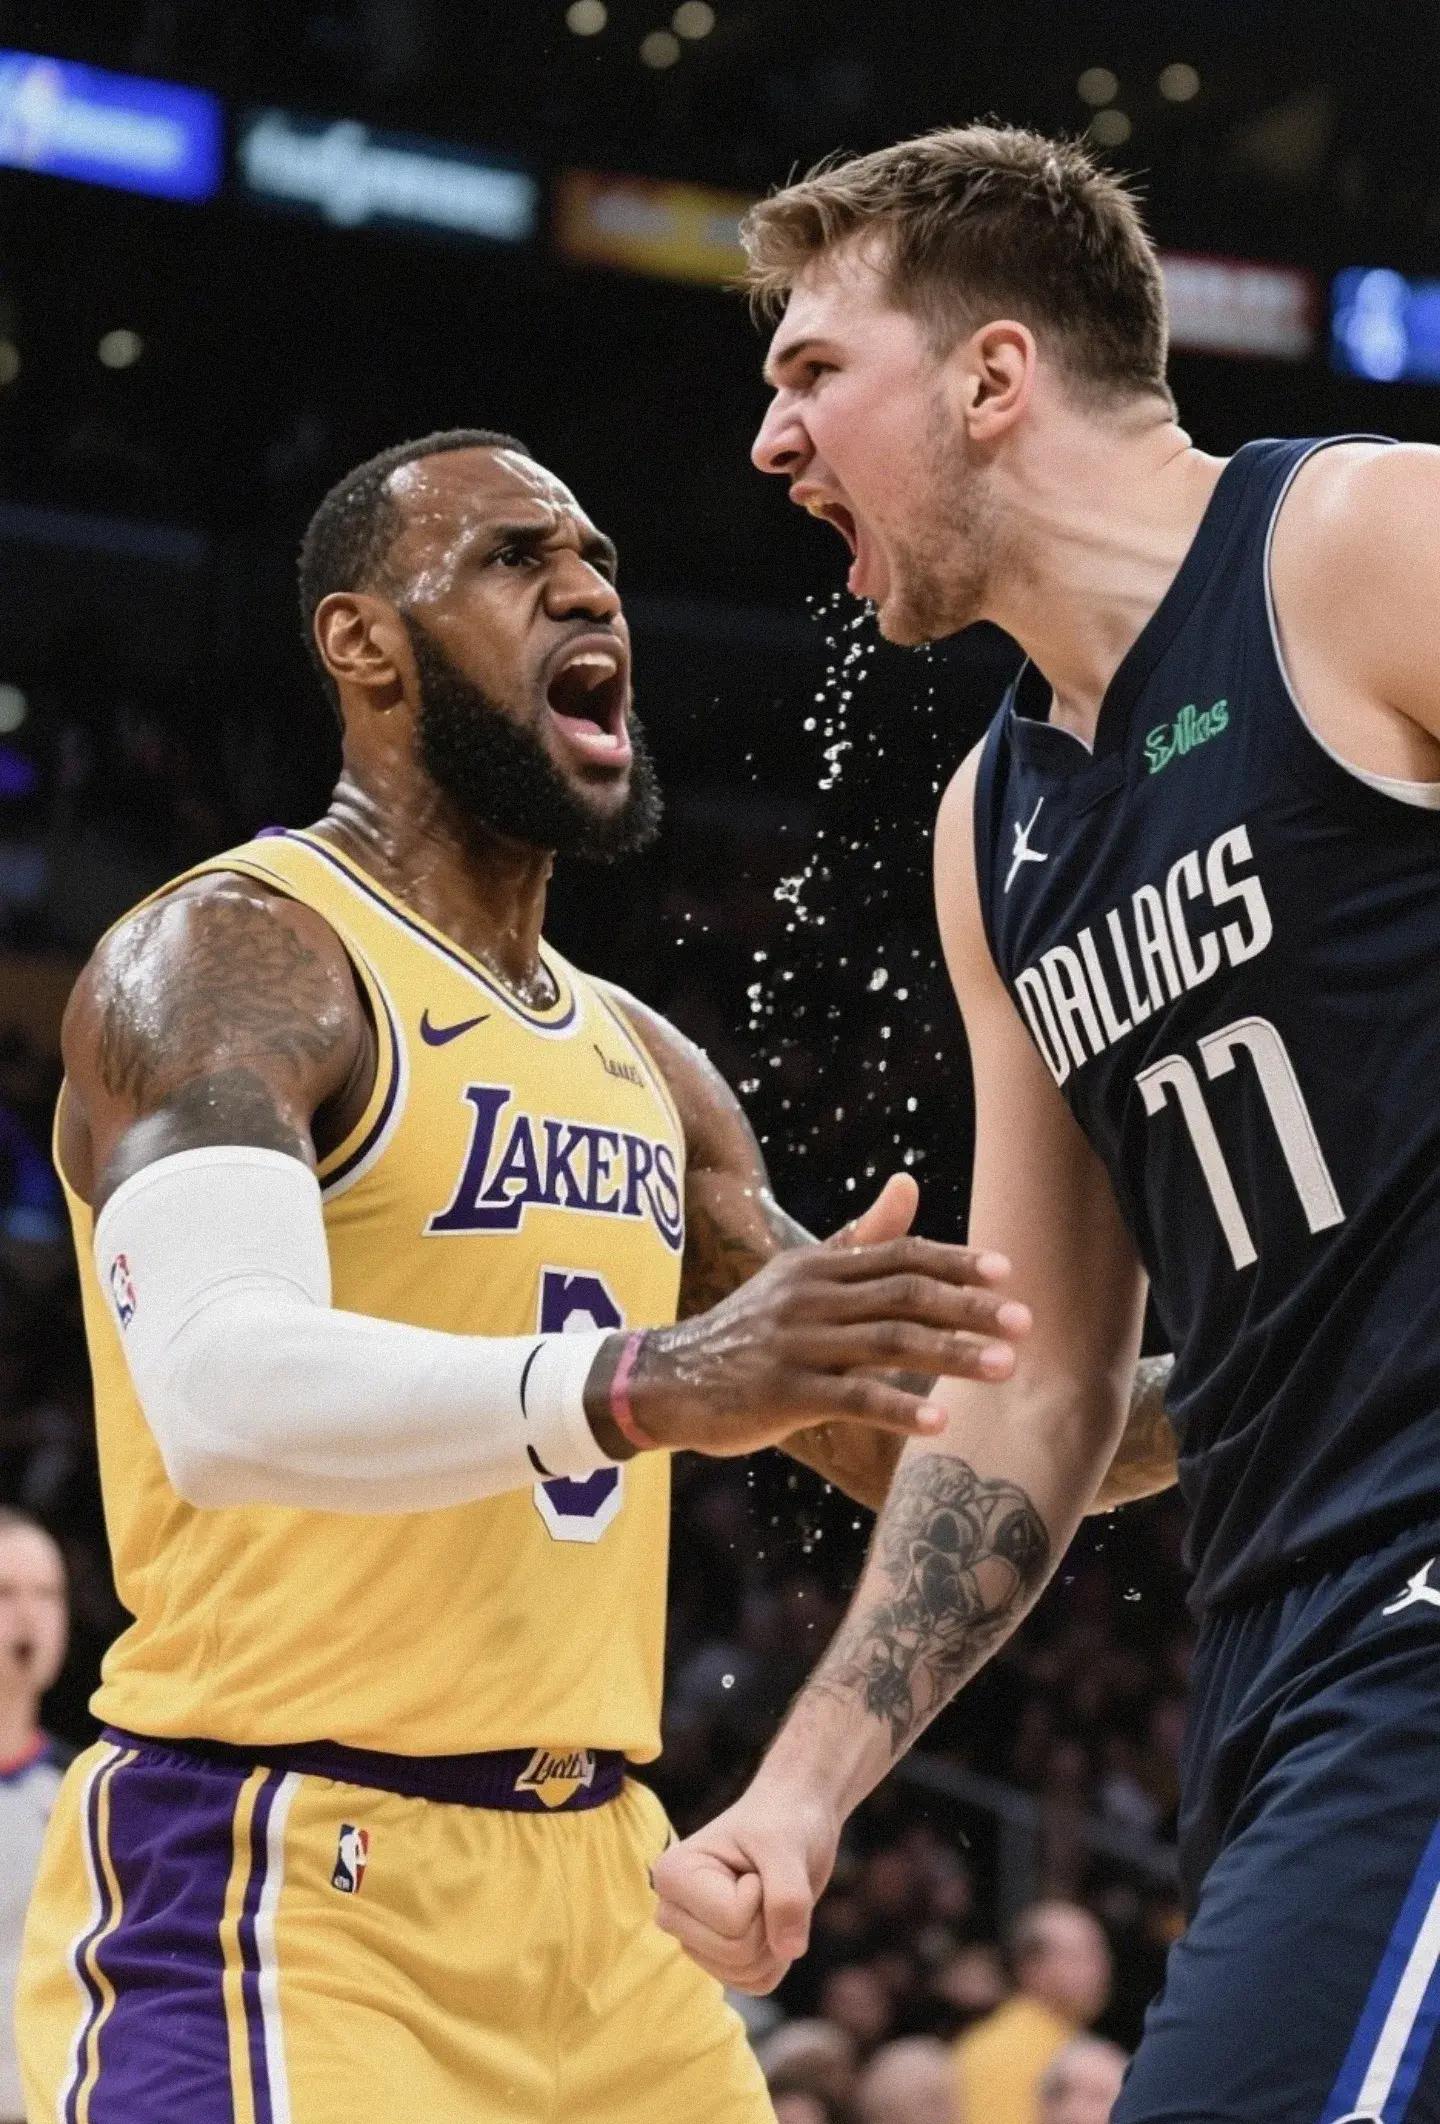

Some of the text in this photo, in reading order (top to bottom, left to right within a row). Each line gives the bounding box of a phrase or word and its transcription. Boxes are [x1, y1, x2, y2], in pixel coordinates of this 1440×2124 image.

[1015, 824, 1273, 1088] DALLACS
[423, 1083, 685, 1253] LAKERS
[1135, 1015, 1346, 1271] 77
